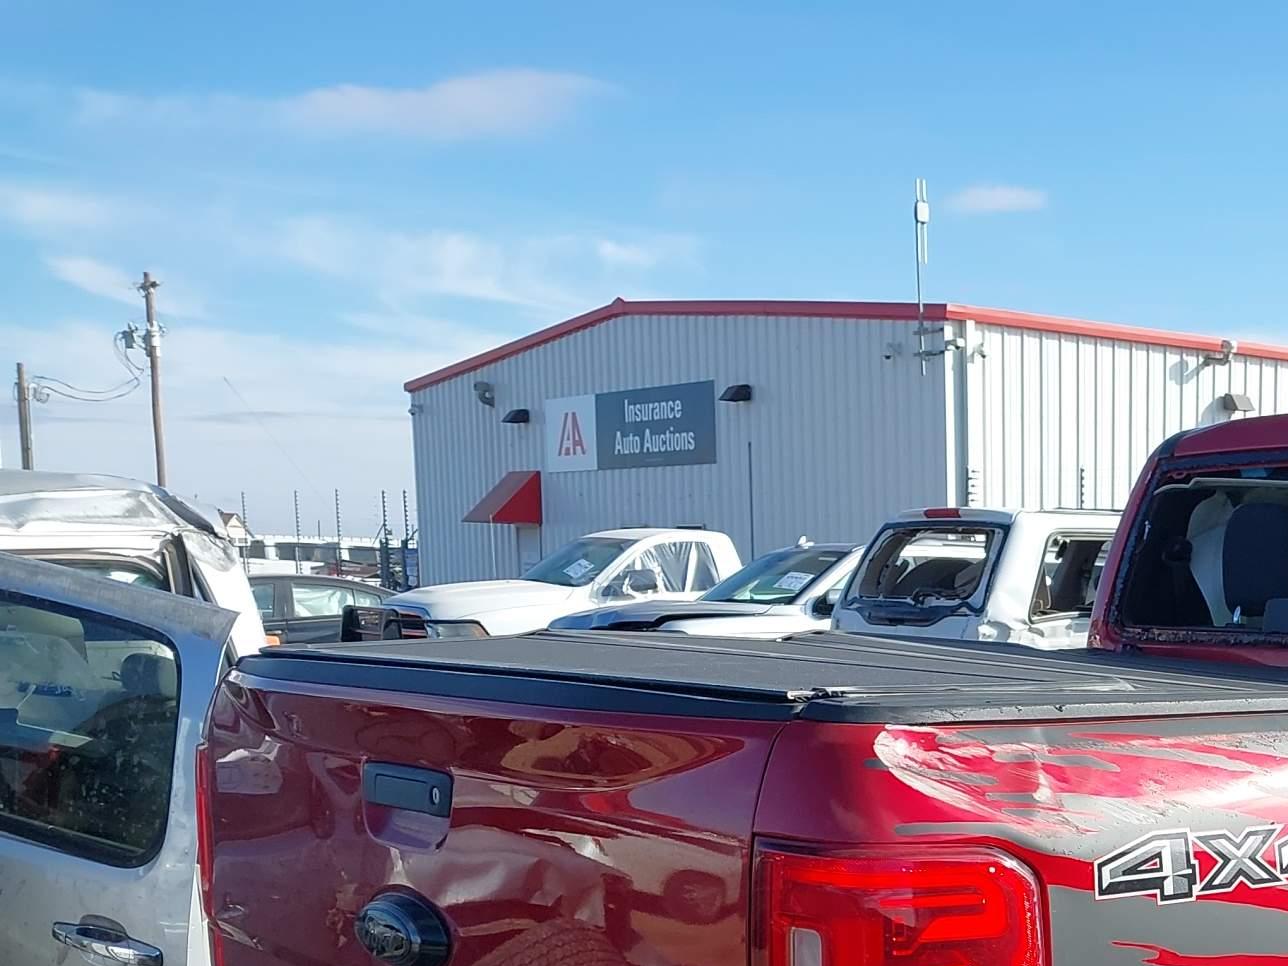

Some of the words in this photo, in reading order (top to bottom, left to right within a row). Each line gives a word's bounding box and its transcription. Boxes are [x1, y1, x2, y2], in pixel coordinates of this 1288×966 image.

[624, 399, 683, 423] Insurance
[614, 431, 640, 456] Auto
[643, 427, 695, 454] Auctions
